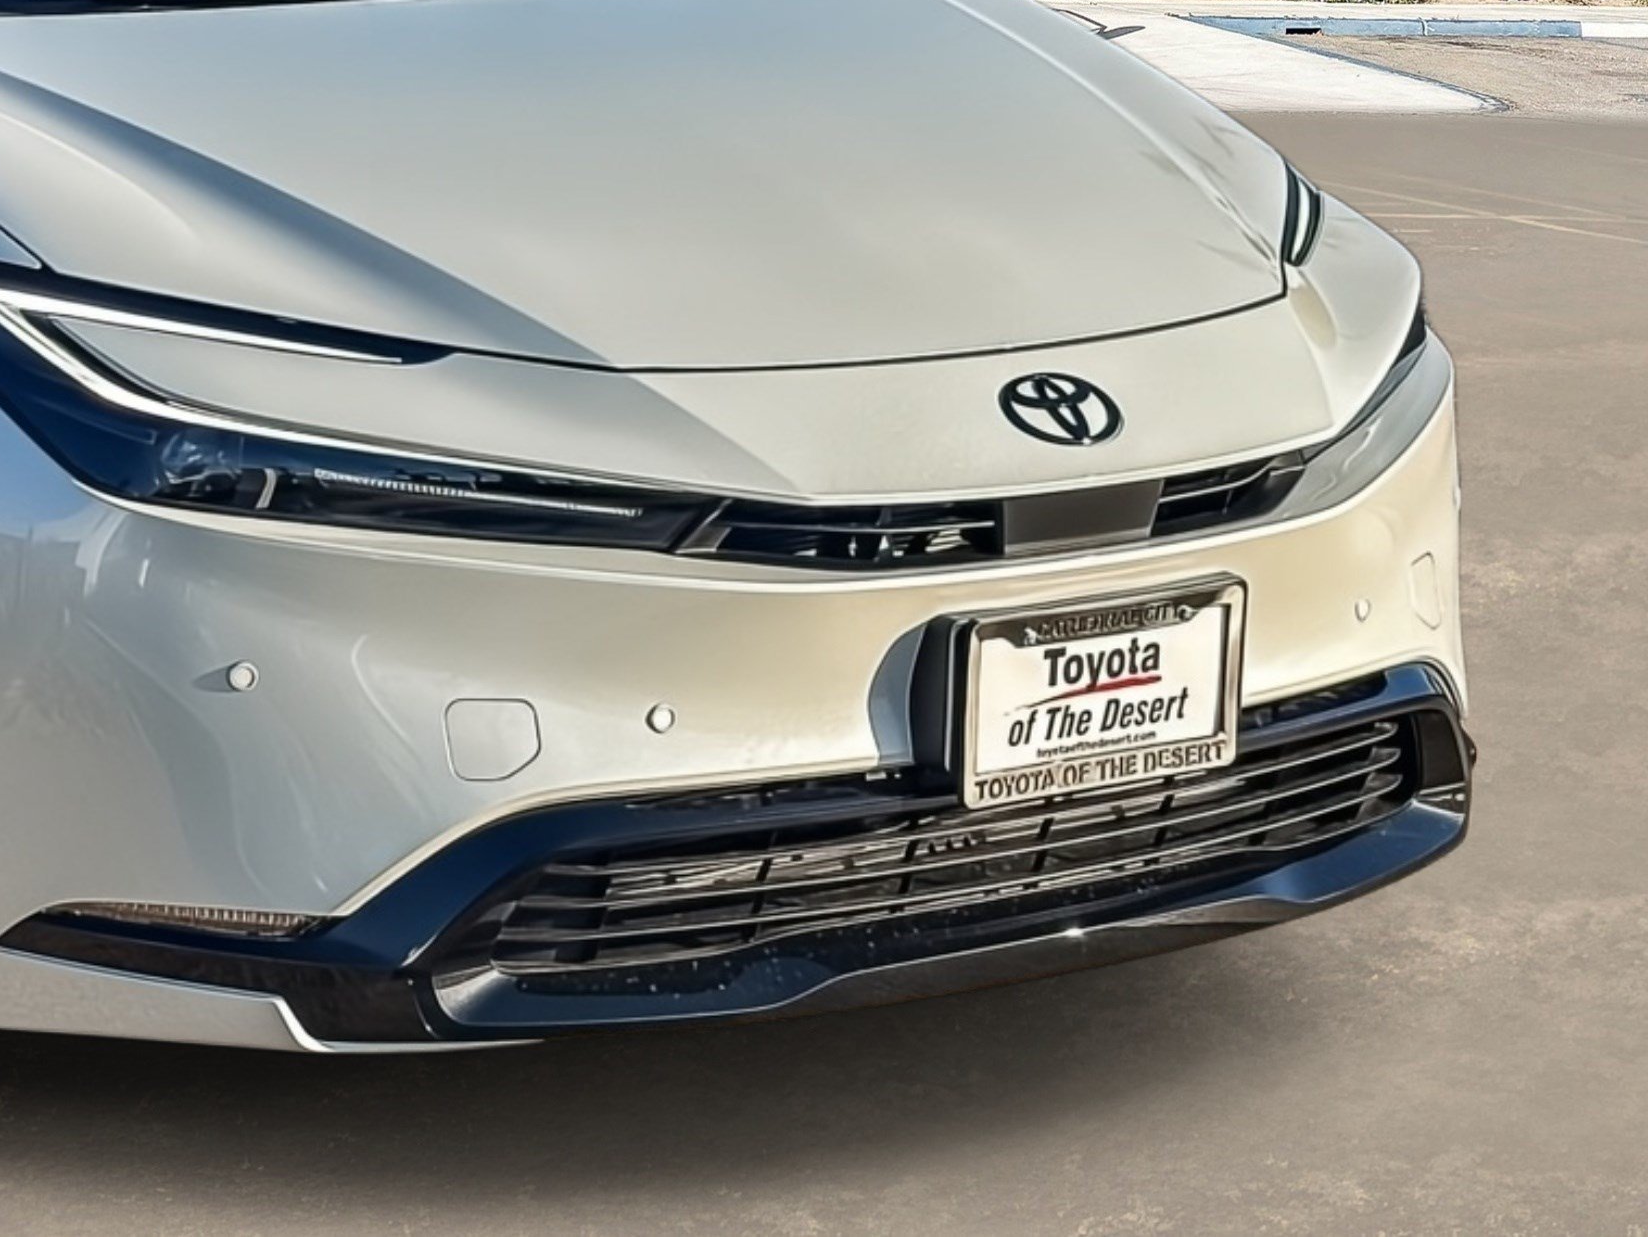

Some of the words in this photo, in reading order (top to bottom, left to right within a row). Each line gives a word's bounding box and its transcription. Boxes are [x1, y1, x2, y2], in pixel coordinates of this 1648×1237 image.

[1043, 638, 1161, 689] Toyota
[1008, 709, 1037, 746] of
[1044, 705, 1093, 741] The
[1100, 688, 1188, 732] Desert
[974, 768, 1056, 800] TOYOTA
[1062, 761, 1095, 787] OF
[1095, 754, 1138, 781] THE
[1143, 740, 1227, 774] DESERT
